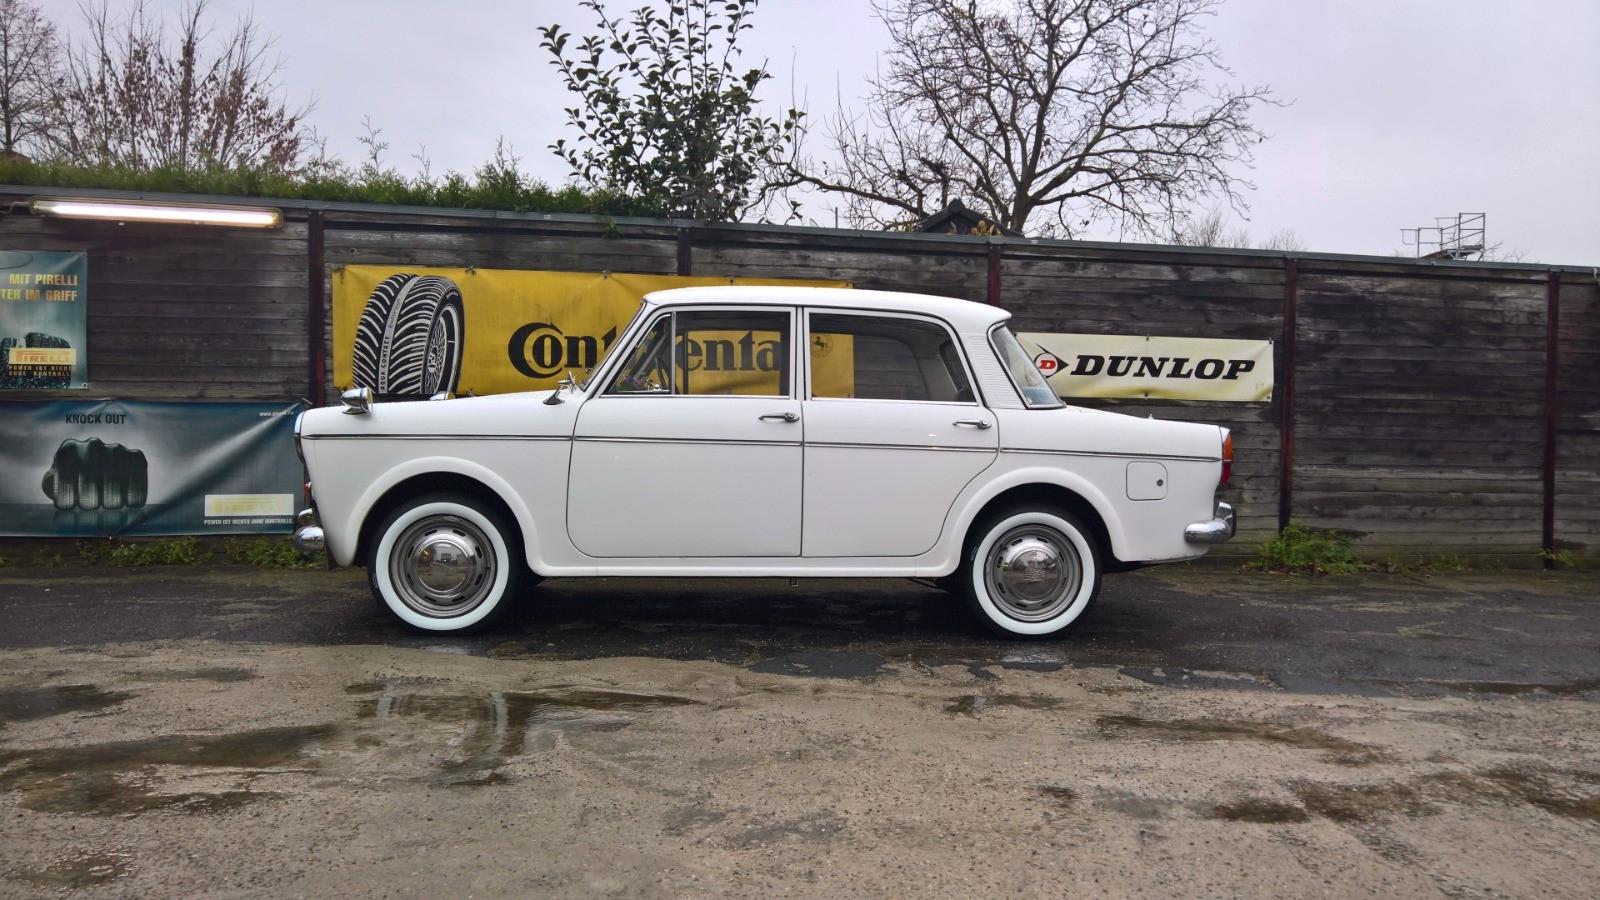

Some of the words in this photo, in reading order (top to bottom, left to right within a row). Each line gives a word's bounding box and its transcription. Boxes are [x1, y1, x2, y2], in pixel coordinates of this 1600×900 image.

[9, 273, 32, 285] MIT
[35, 273, 78, 286] PIRELLI
[26, 288, 40, 300] IM
[45, 289, 78, 302] GRIFF
[381, 336, 390, 369] CONTACT
[1070, 354, 1256, 380] DUNLOP
[65, 413, 102, 425] KNOCK
[105, 413, 127, 425] OUT
